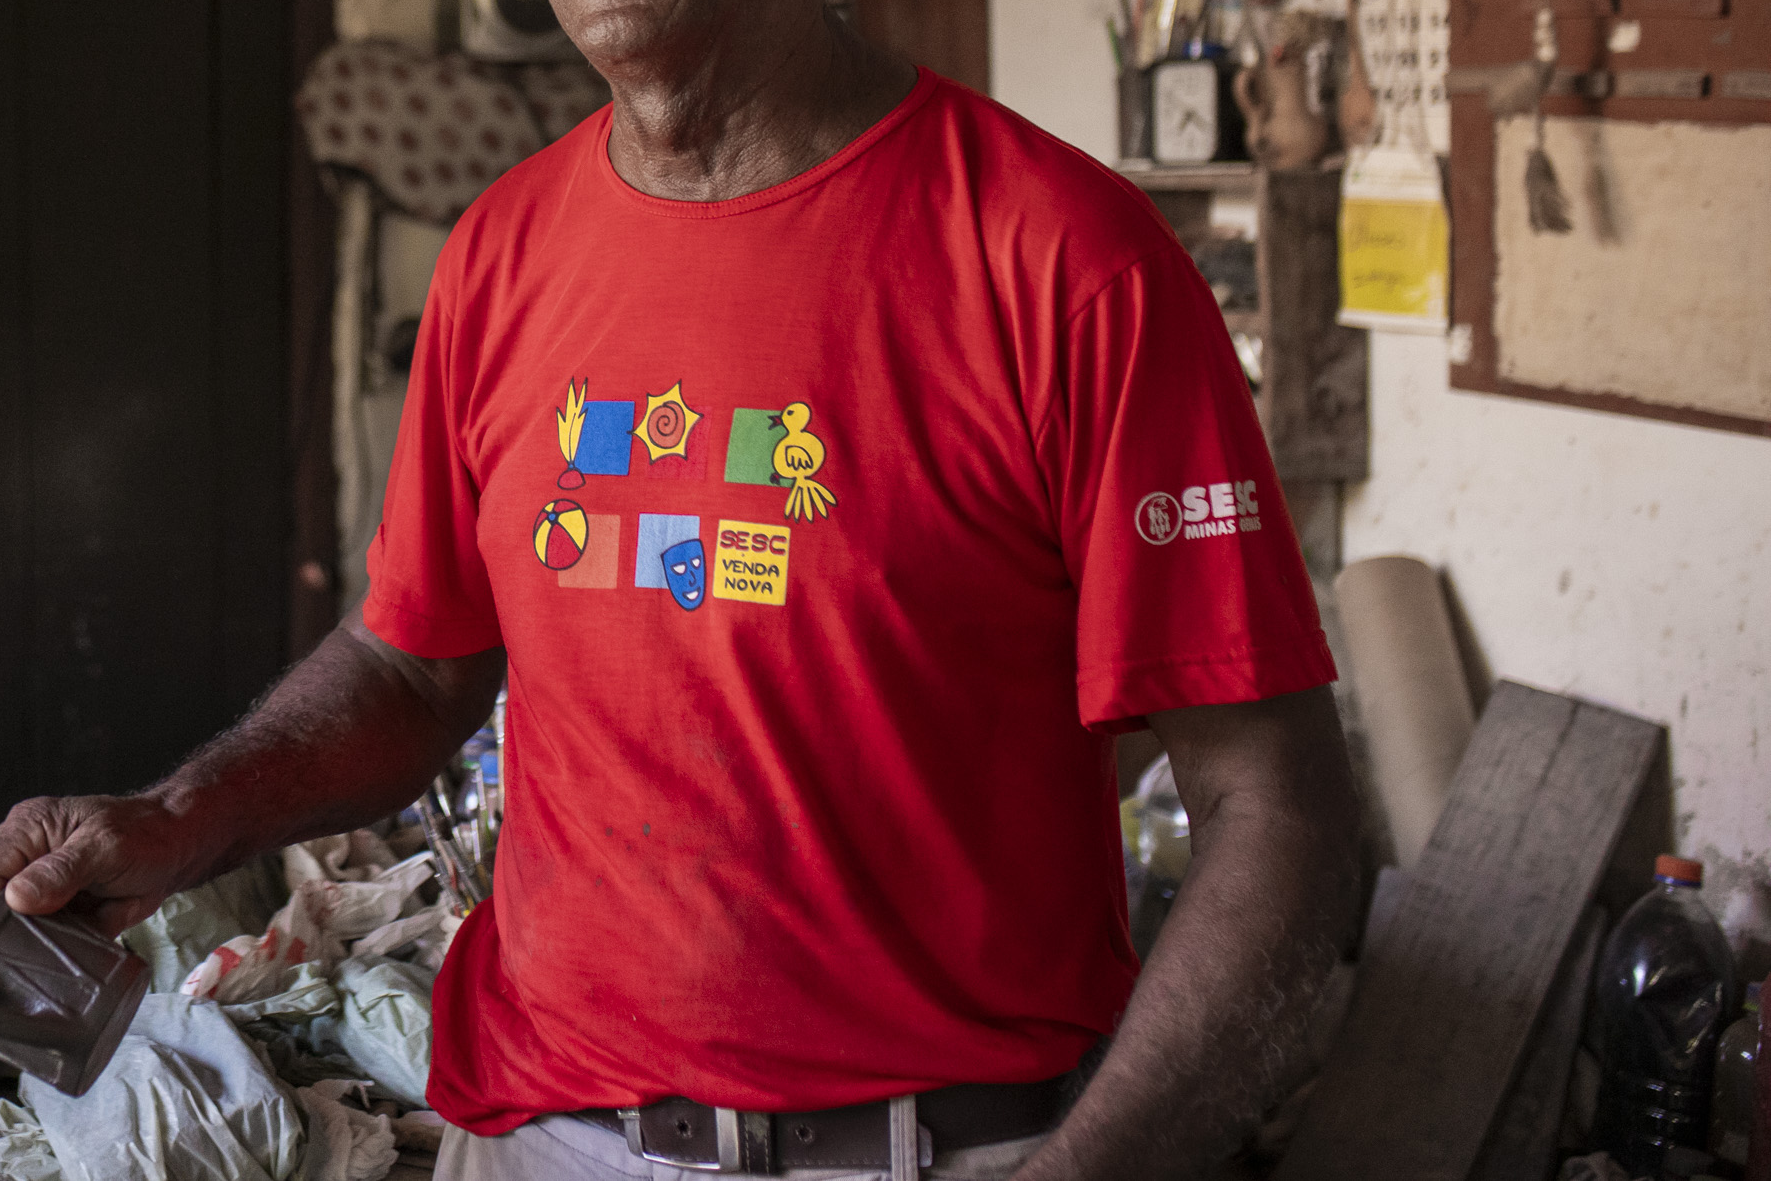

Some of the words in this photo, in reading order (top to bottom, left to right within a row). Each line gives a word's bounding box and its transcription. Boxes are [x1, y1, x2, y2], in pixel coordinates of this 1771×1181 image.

[1182, 480, 1259, 522] SESC
[1184, 519, 1236, 540] MINAS
[720, 529, 787, 555] SESC
[722, 559, 779, 578] VENDA
[724, 576, 773, 594] NOVA
